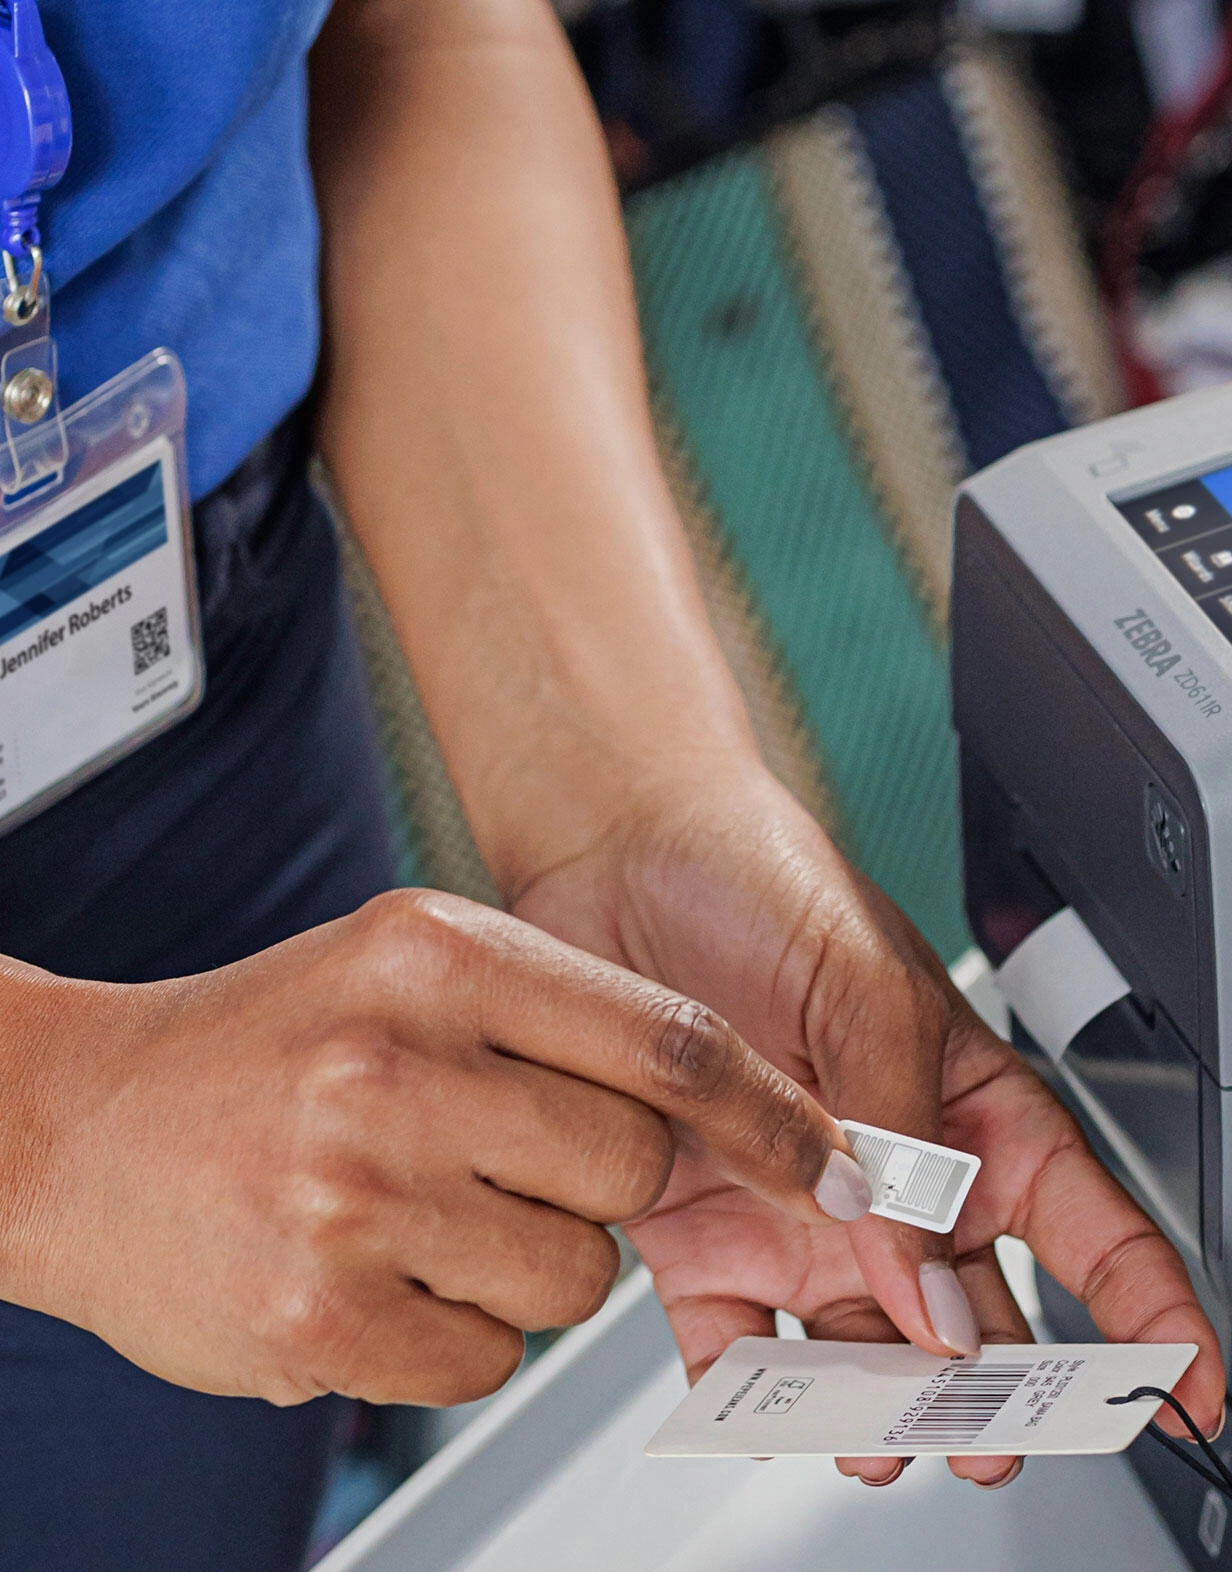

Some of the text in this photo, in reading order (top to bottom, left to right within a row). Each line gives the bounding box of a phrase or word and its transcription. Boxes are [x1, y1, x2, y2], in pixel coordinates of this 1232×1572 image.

[0, 585, 133, 679] Jennifer Roberts
[1114, 608, 1222, 718] ZEBRA ZD611R
